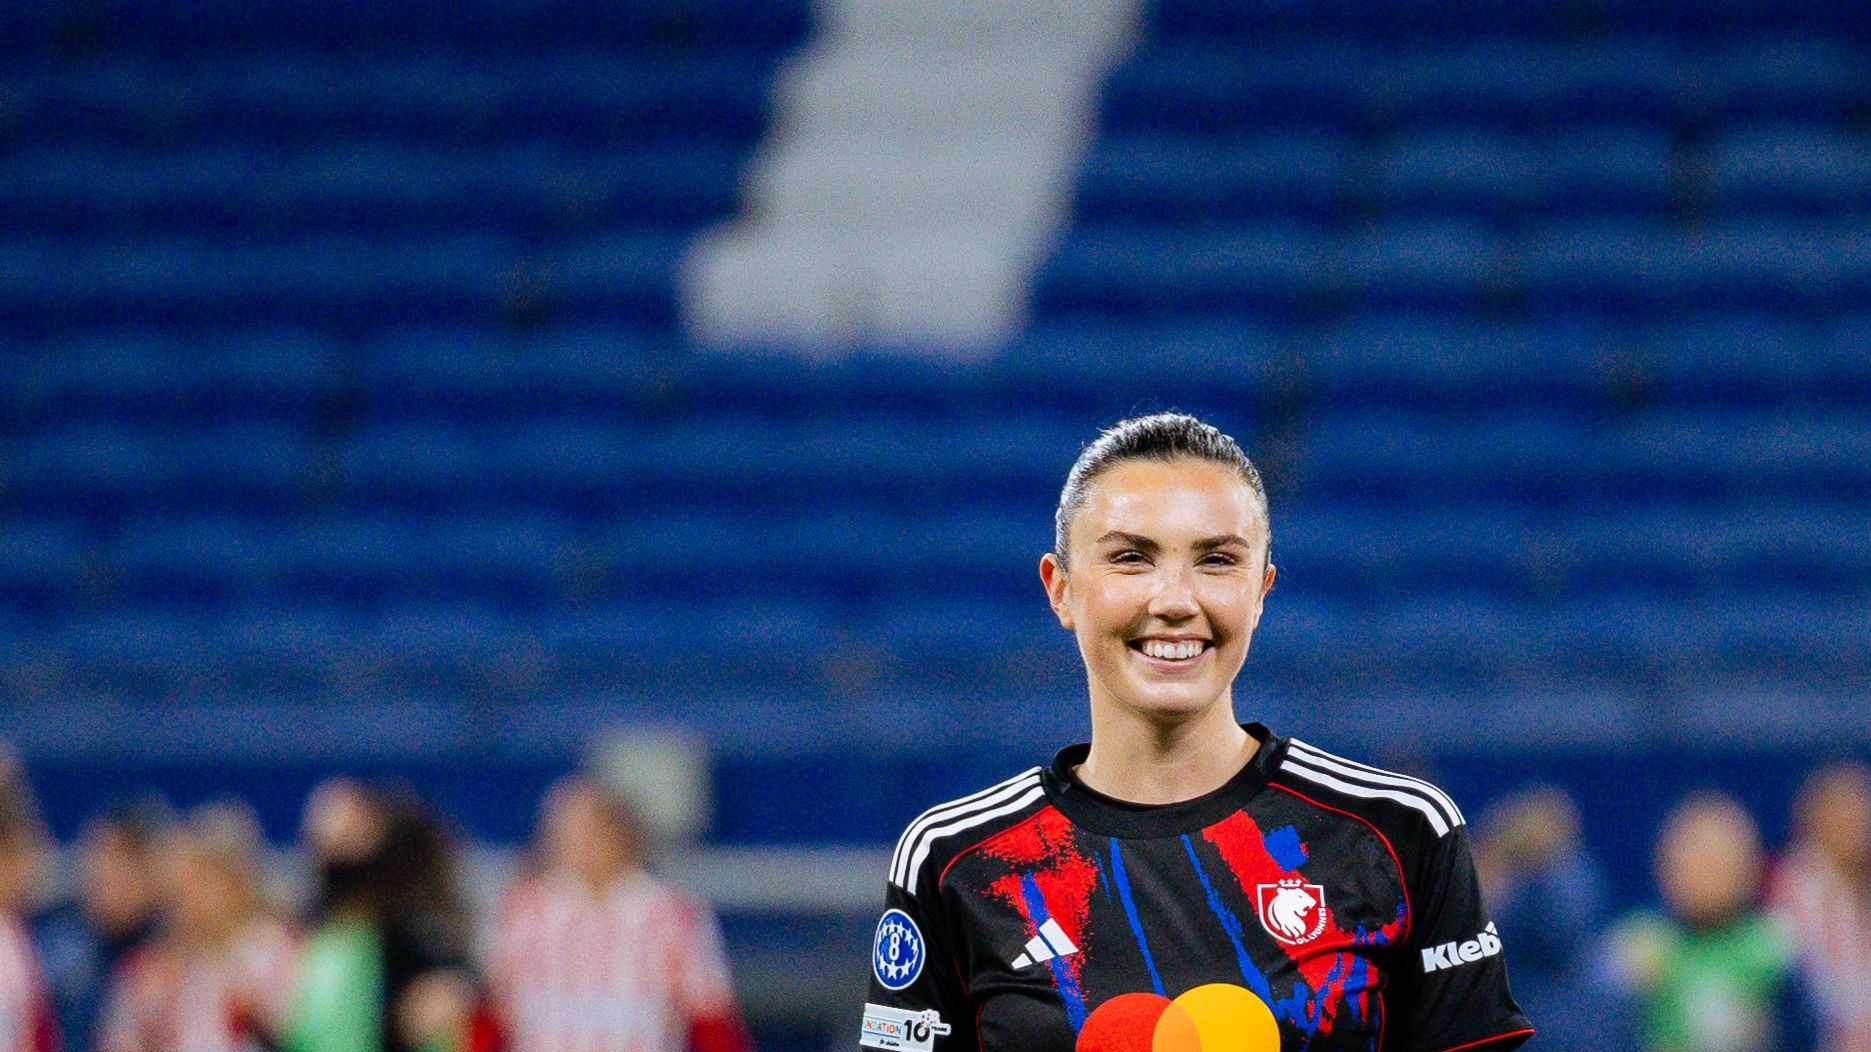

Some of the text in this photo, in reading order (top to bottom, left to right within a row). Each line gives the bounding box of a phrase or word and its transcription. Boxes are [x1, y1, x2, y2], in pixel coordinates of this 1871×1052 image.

[888, 932, 900, 961] 8
[1296, 937, 1309, 945] OL
[1421, 931, 1503, 974] Kleb
[904, 1019, 931, 1043] 10
